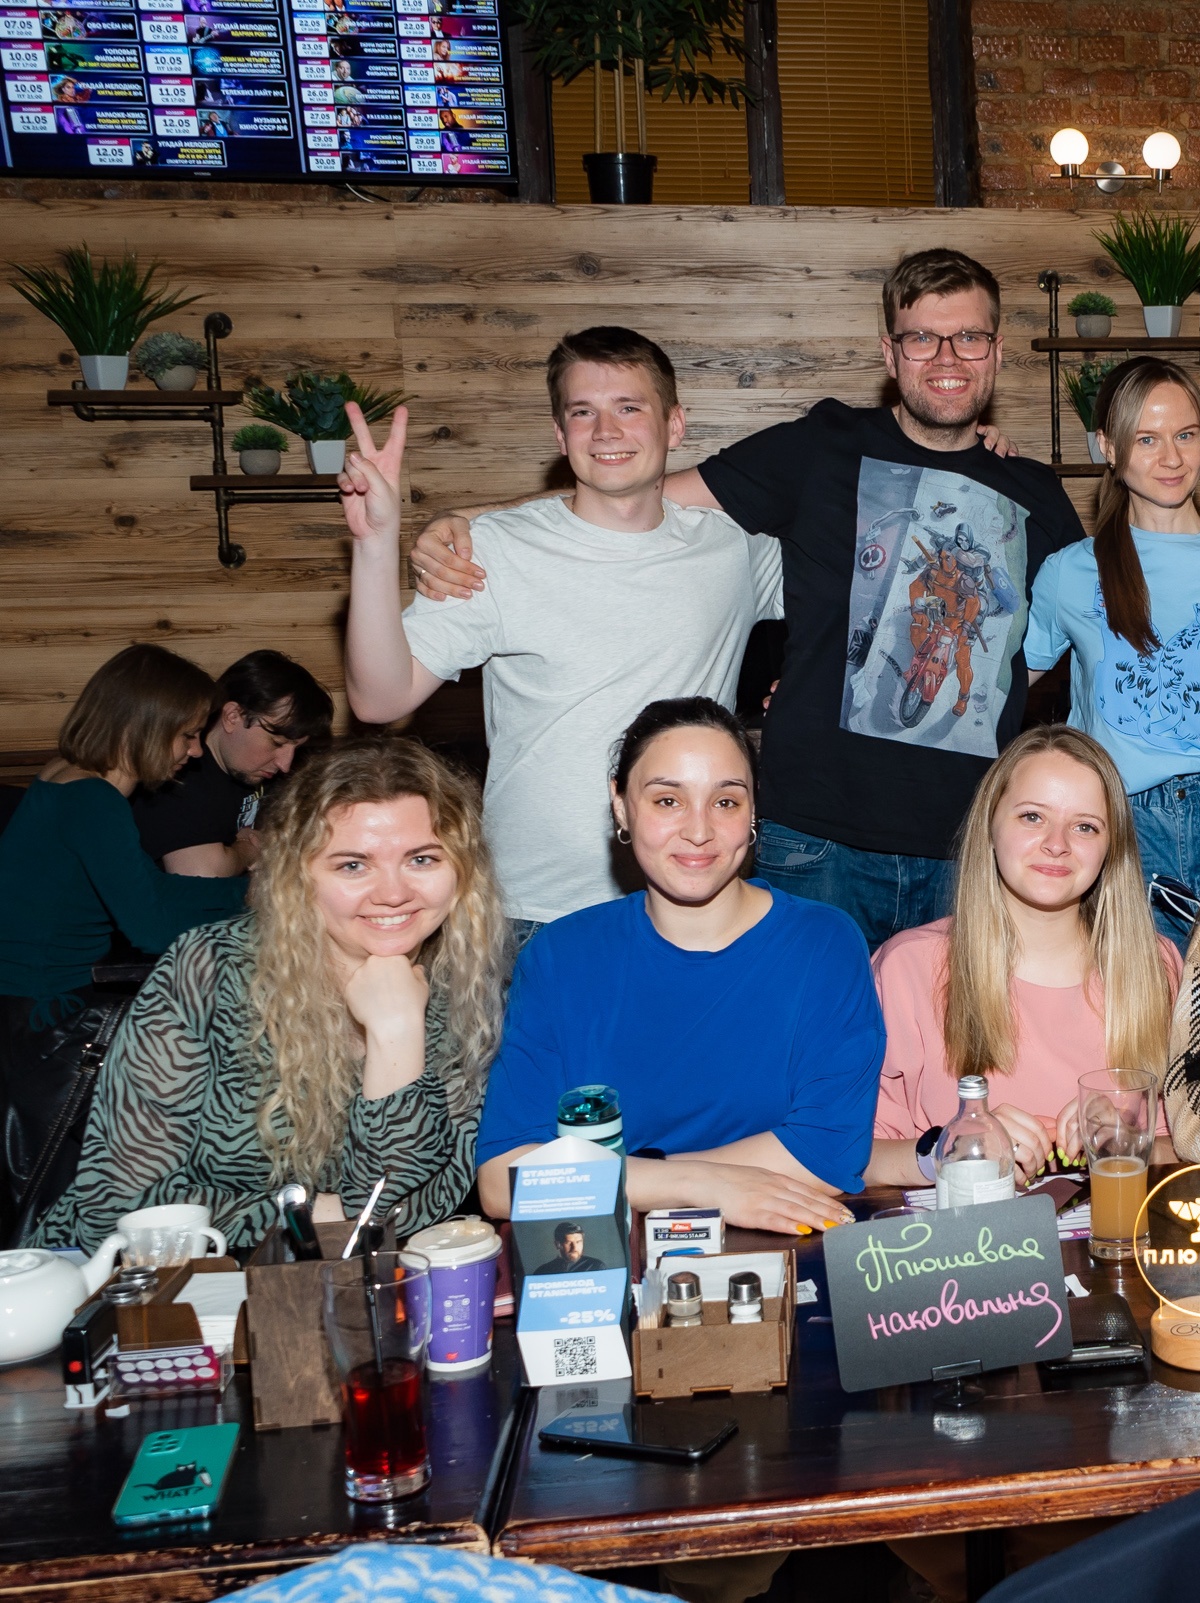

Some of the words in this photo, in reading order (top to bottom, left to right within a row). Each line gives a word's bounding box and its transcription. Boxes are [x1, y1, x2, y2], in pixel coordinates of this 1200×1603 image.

[4, 20, 32, 29] 07.05
[150, 25, 178, 33] 08.05
[10, 52, 38, 60] 10.05
[154, 56, 182, 65] 10.05
[14, 84, 42, 92] 10.05
[159, 88, 186, 96] 11.05
[20, 116, 47, 124] 11.05
[163, 119, 190, 127] 12.05
[96, 148, 124, 156] 12.05
[522, 1168, 576, 1178] STANDUP
[522, 1178, 537, 1186] ОТ
[540, 1176, 565, 1185] МТС
[566, 1174, 590, 1182] LIVE
[856, 1223, 1045, 1292] Плюшевая
[528, 1279, 595, 1290] ПРОМОКОД
[561, 1308, 616, 1324] -25%
[868, 1279, 1062, 1348] наковальня
[143, 1486, 204, 1502] WHAT?
